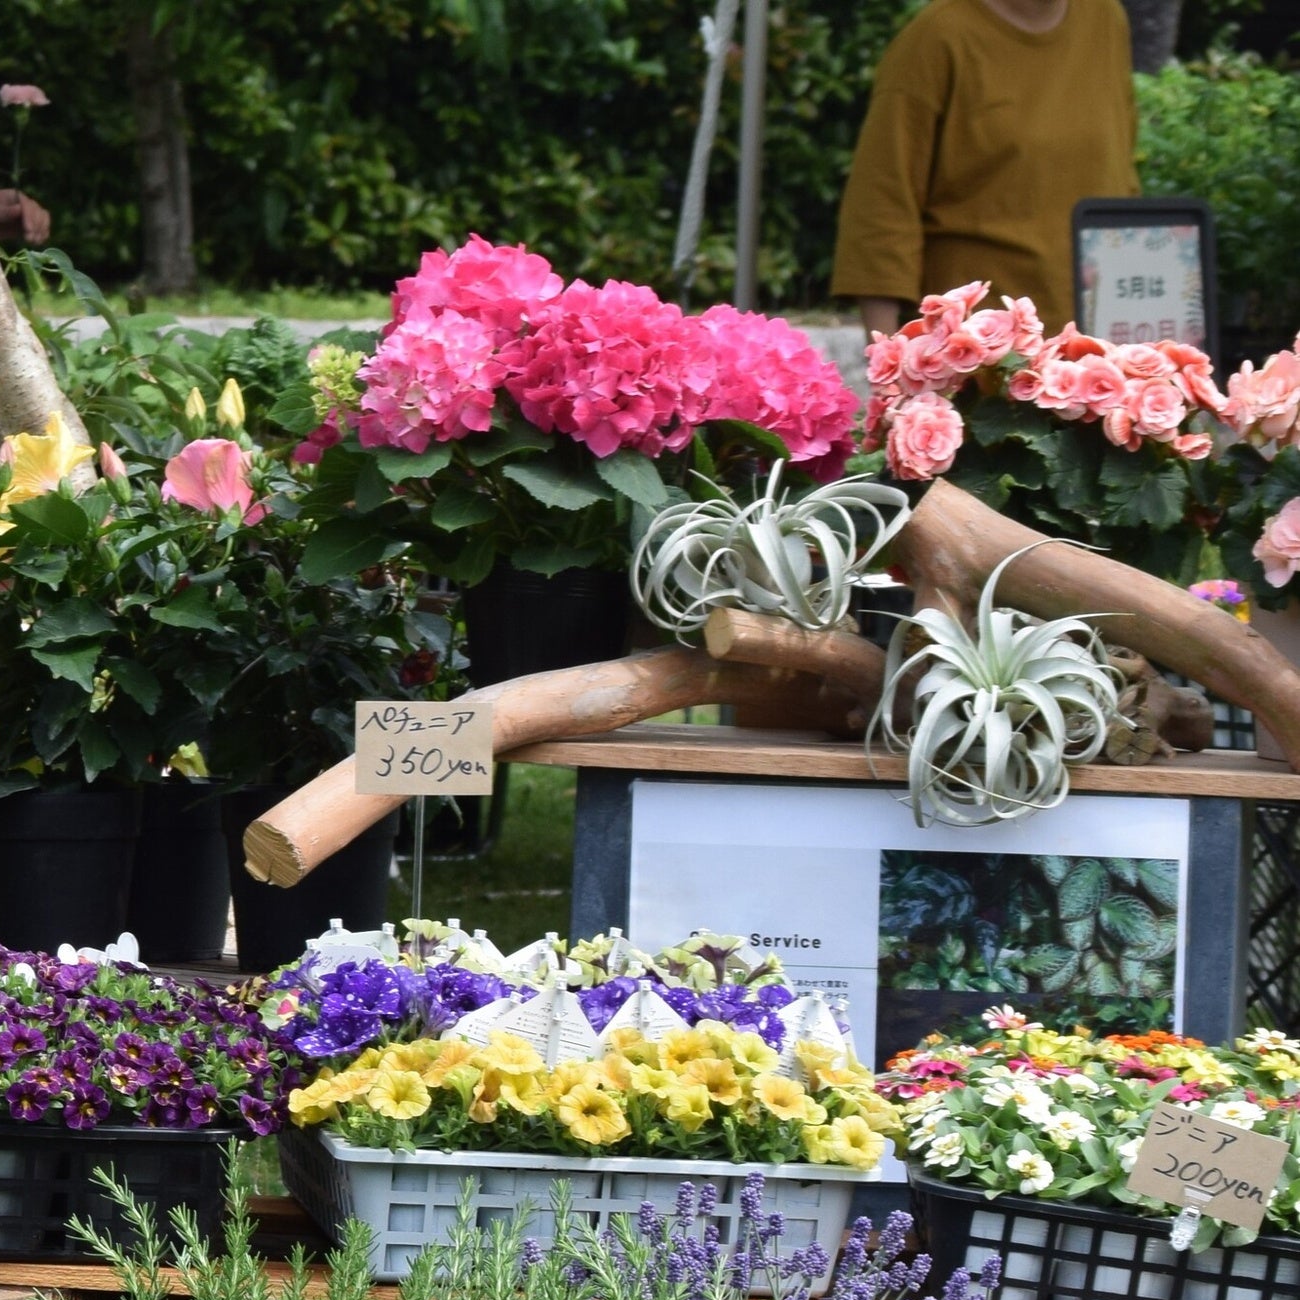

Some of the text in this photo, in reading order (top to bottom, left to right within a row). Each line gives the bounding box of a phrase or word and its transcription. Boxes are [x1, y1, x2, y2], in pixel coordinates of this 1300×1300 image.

[1116, 275, 1167, 300] 5月は
[361, 706, 475, 735] ペチュニア
[375, 744, 488, 782] 350yen
[750, 933, 822, 949] Service
[1154, 1111, 1238, 1154] ジニア
[1152, 1152, 1264, 1204] 200yen
